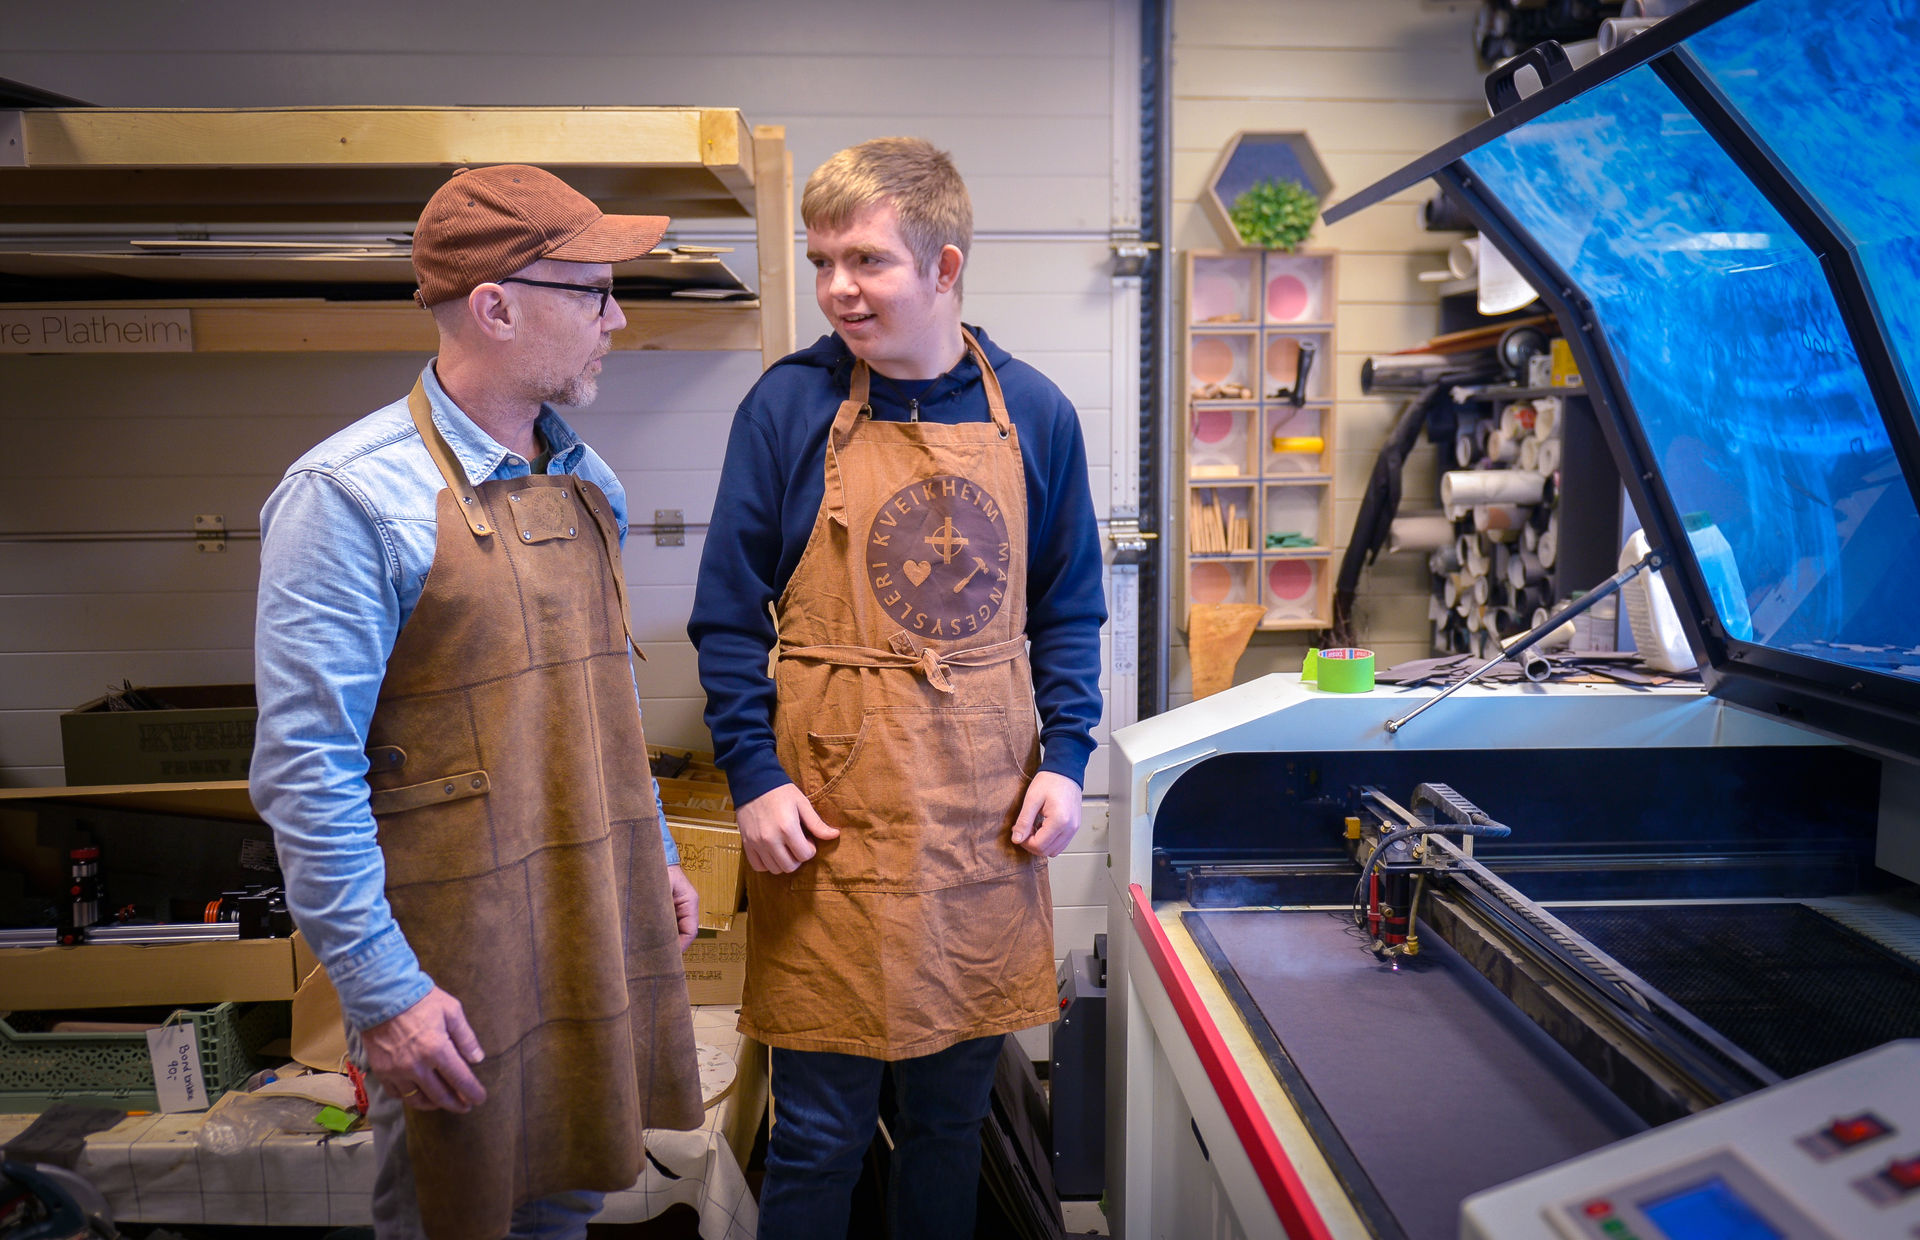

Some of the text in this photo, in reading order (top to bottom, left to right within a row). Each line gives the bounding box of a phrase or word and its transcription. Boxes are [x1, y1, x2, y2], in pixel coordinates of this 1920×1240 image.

[42, 314, 182, 345] Platheim
[872, 479, 1009, 636] KVEIKHEIM MANGESYSLERI
[179, 1044, 192, 1073] Bord
